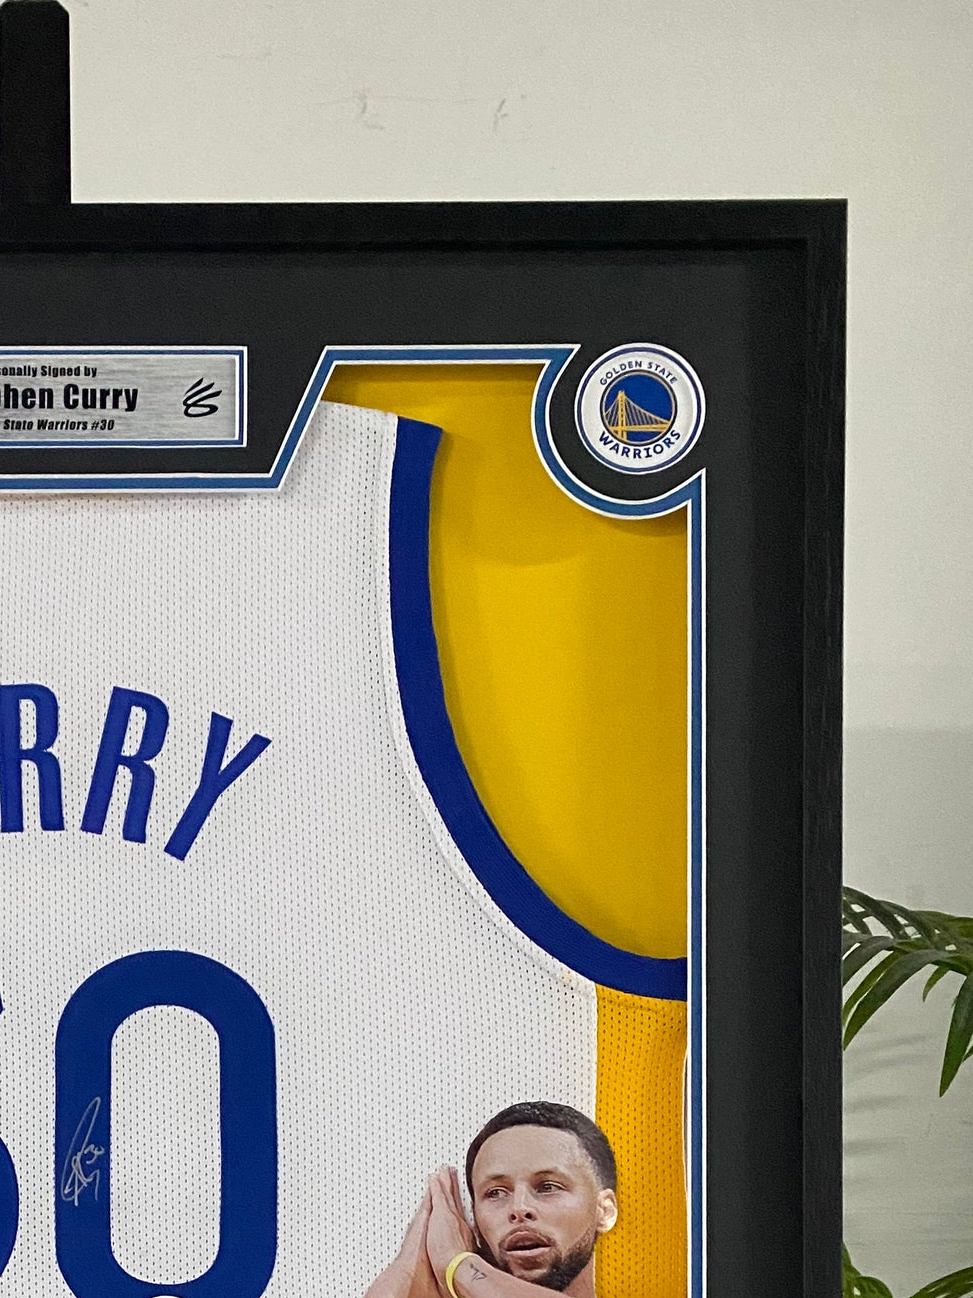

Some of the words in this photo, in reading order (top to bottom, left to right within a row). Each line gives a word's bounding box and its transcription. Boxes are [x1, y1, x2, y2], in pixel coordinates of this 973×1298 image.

[40, 365, 82, 378] Signed
[83, 365, 97, 378] by
[599, 361, 643, 386] GOLDEN
[647, 362, 678, 384] STATE
[63, 383, 139, 412] Curry
[3, 419, 33, 431] State
[36, 419, 88, 431] Warriors
[91, 419, 115, 431] #30
[598, 430, 681, 459] WARRIORS
